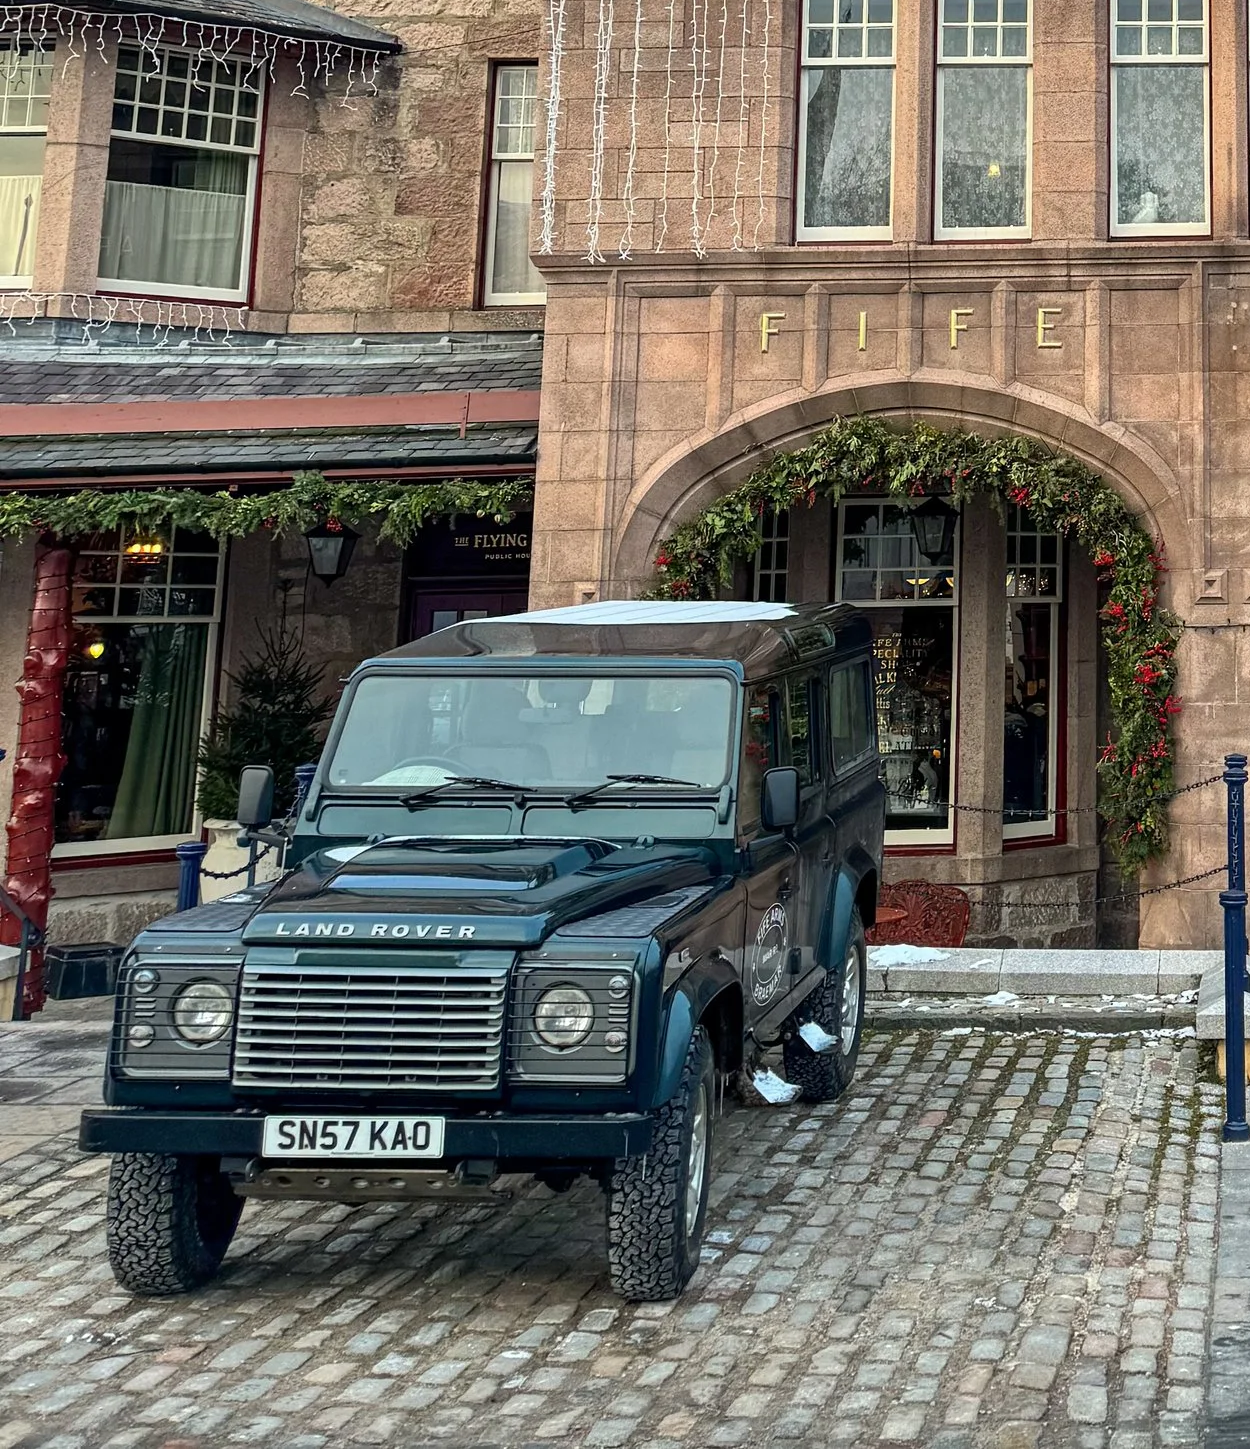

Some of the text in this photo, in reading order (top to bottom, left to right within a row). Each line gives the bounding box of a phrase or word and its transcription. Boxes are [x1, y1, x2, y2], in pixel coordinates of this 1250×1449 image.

[761, 307, 1063, 353] FIFE
[455, 534, 527, 547] THE FLYING
[275, 922, 476, 939] LAND ROVER
[277, 1120, 432, 1151] SN57 KAO
